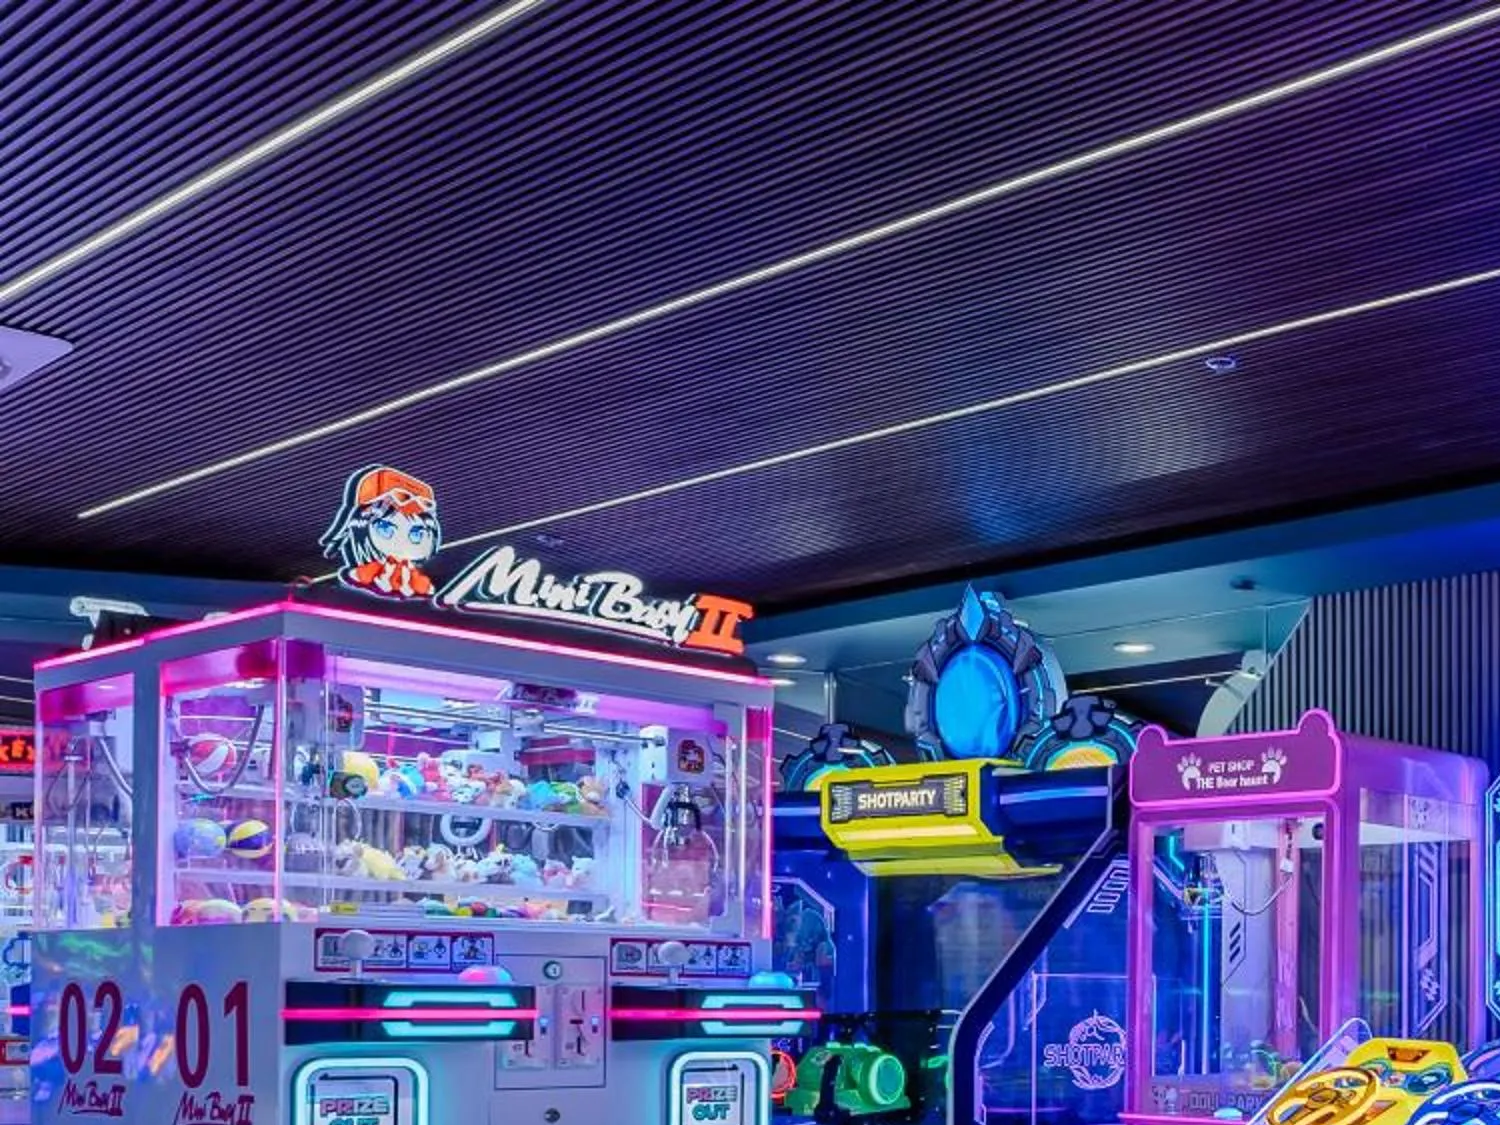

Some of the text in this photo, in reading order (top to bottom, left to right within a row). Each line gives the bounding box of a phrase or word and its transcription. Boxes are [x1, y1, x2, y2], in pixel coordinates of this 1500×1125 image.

[857, 789, 936, 810] SHOTPARTY
[59, 980, 123, 1074] 02
[175, 980, 249, 1089] 01
[319, 1096, 390, 1118] PRIZE
